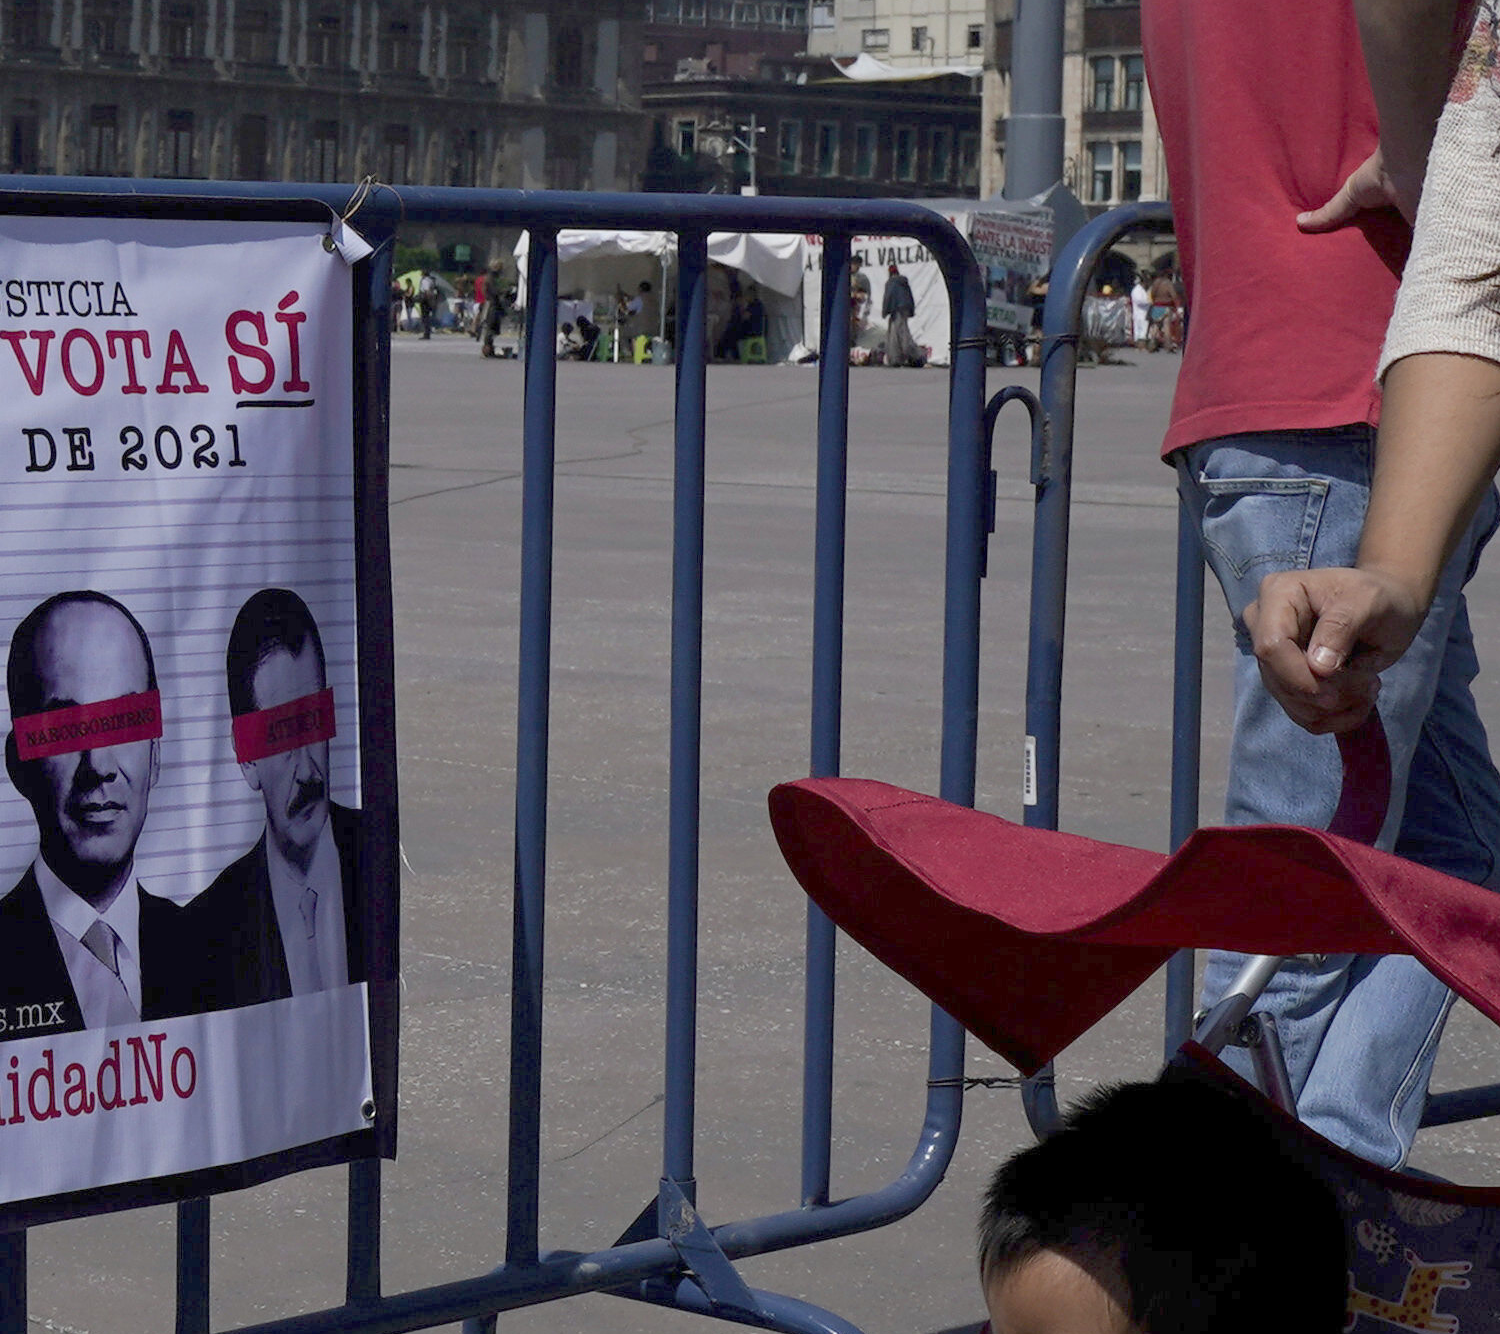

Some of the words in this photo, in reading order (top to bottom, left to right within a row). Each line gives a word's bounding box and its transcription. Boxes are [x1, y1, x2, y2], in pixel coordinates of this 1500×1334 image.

[225, 289, 312, 396] SÍ
[21, 425, 96, 473] DE
[118, 423, 247, 472] 2021
[24, 706, 157, 749] NARCOGOBIERNO
